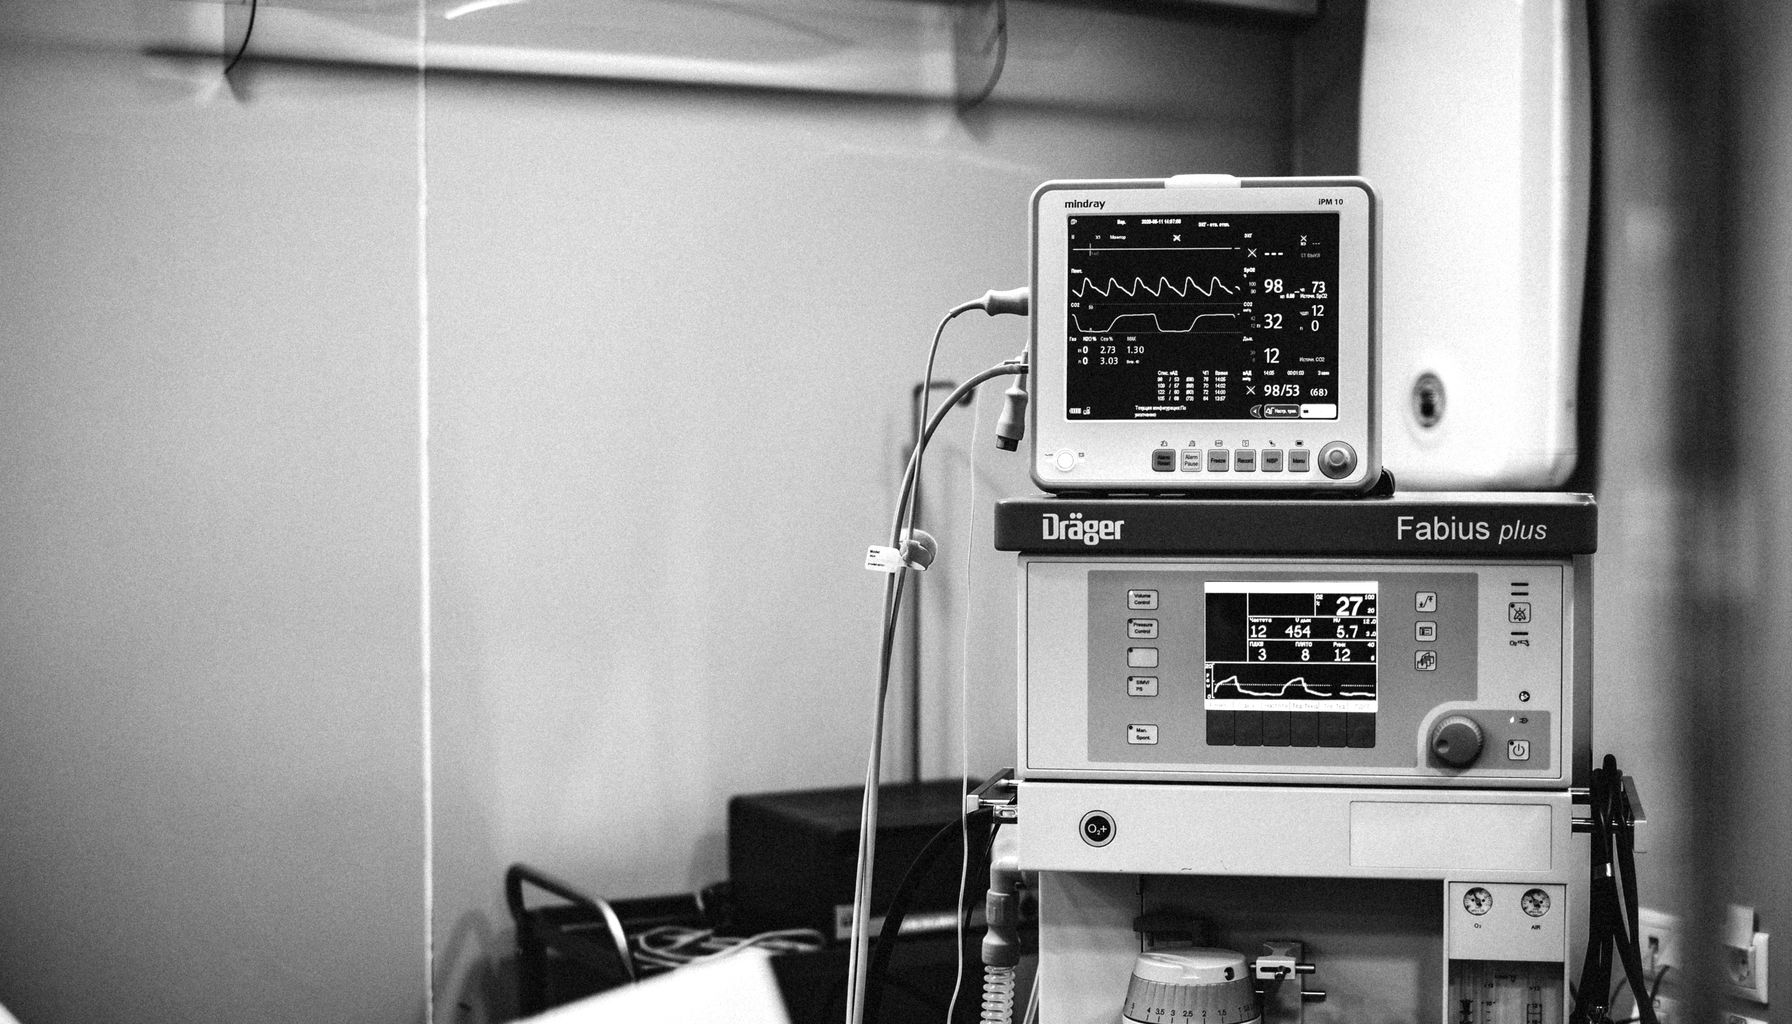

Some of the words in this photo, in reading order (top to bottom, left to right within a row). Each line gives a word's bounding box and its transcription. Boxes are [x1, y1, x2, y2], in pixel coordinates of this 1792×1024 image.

[1065, 200, 1105, 210] mindray
[1264, 279, 1283, 293] 98
[1311, 281, 1326, 294] 73
[1312, 305, 1324, 316] 12
[1264, 314, 1282, 329] 32
[1311, 320, 1319, 331] 0
[1083, 346, 1088, 354] 0
[1100, 346, 1116, 354] 2.73
[1127, 346, 1144, 354] 1.30
[1264, 348, 1279, 363] 12
[1083, 357, 1088, 365] 0
[1264, 384, 1300, 396] 98/53
[1310, 388, 1328, 396] (68)
[1043, 513, 1124, 545] Dräger
[1398, 516, 1490, 540] Fabius
[1497, 520, 1548, 545] plus
[1336, 596, 1363, 616] 27
[1250, 625, 1267, 638] 12
[1285, 625, 1311, 638] 454
[1336, 625, 1358, 638] 5.7
[1258, 648, 1266, 660] 3
[1301, 648, 1310, 661] 8
[1334, 649, 1350, 662] 12
[1155, 1008, 1165, 1016] 3.5
